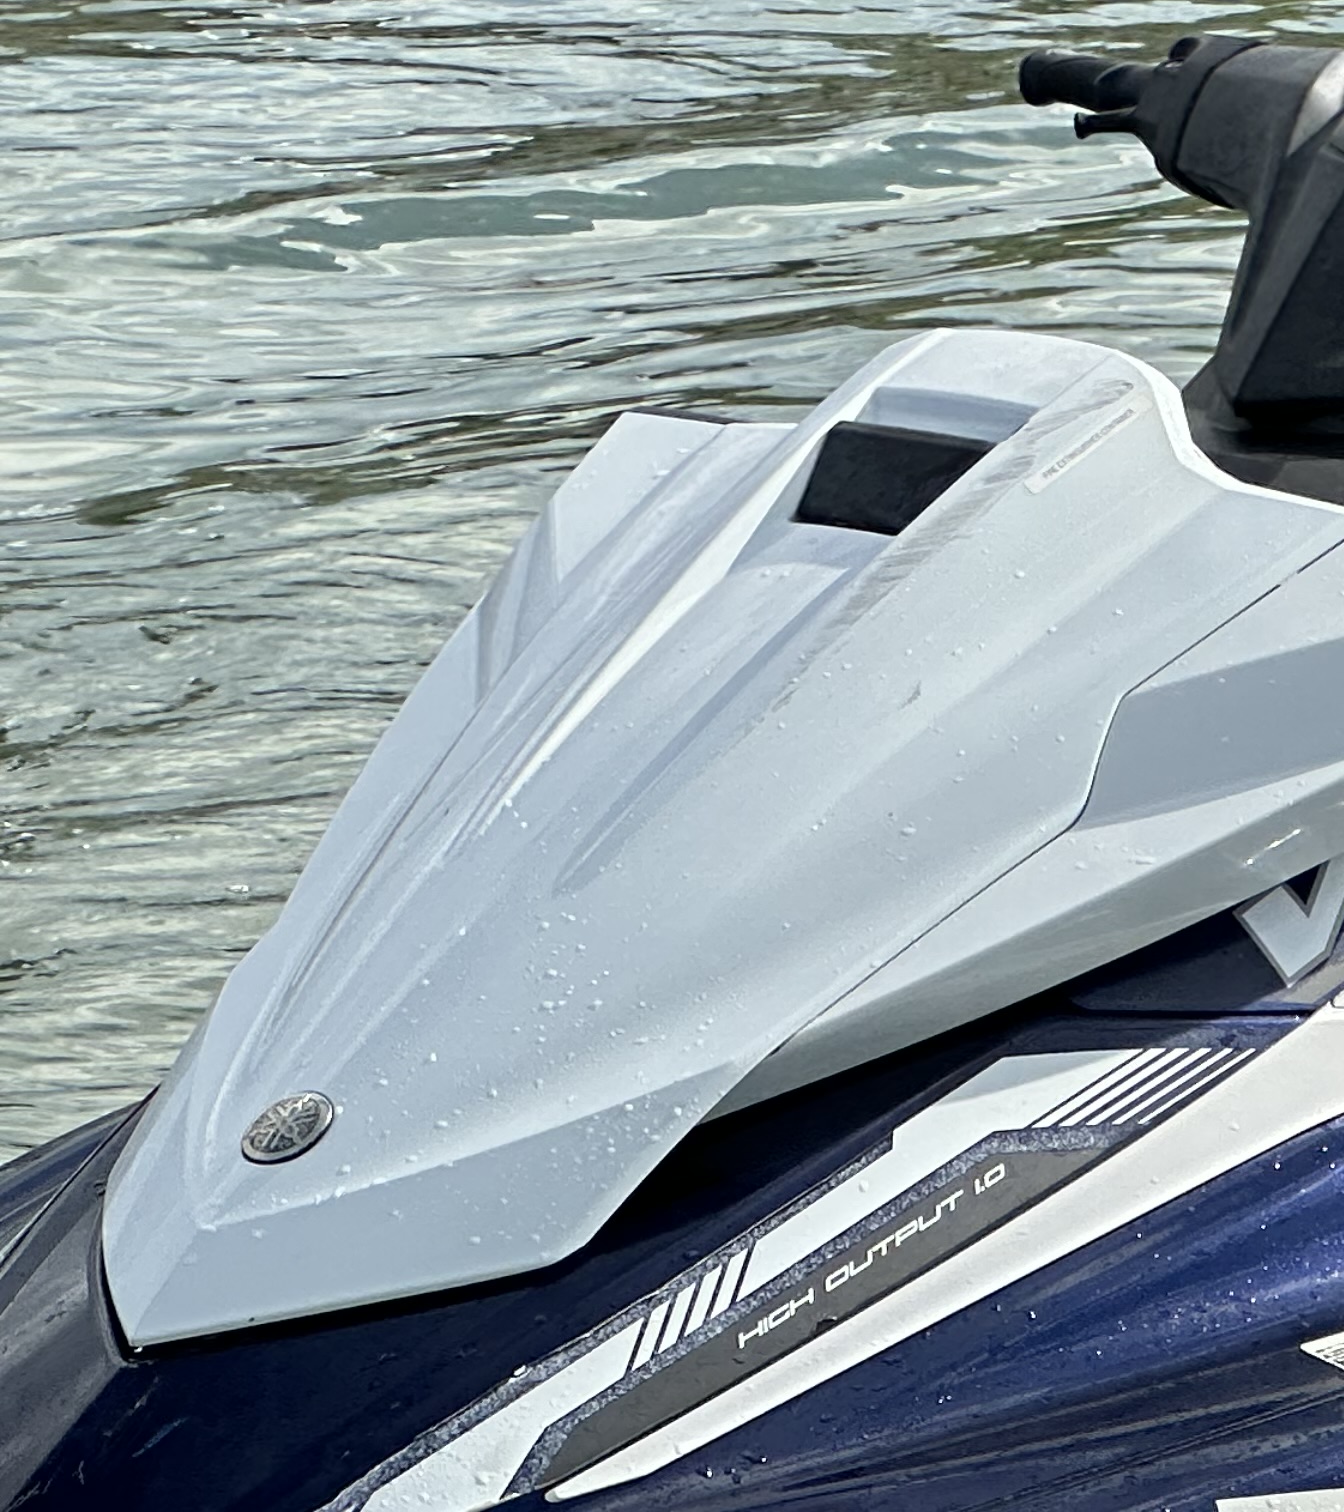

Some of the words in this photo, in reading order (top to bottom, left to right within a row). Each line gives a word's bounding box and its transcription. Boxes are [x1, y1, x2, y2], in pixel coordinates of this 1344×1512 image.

[738, 1287, 815, 1350] HIGH
[825, 1189, 964, 1292] OUTPUT
[974, 1162, 1006, 1195] 1.0
